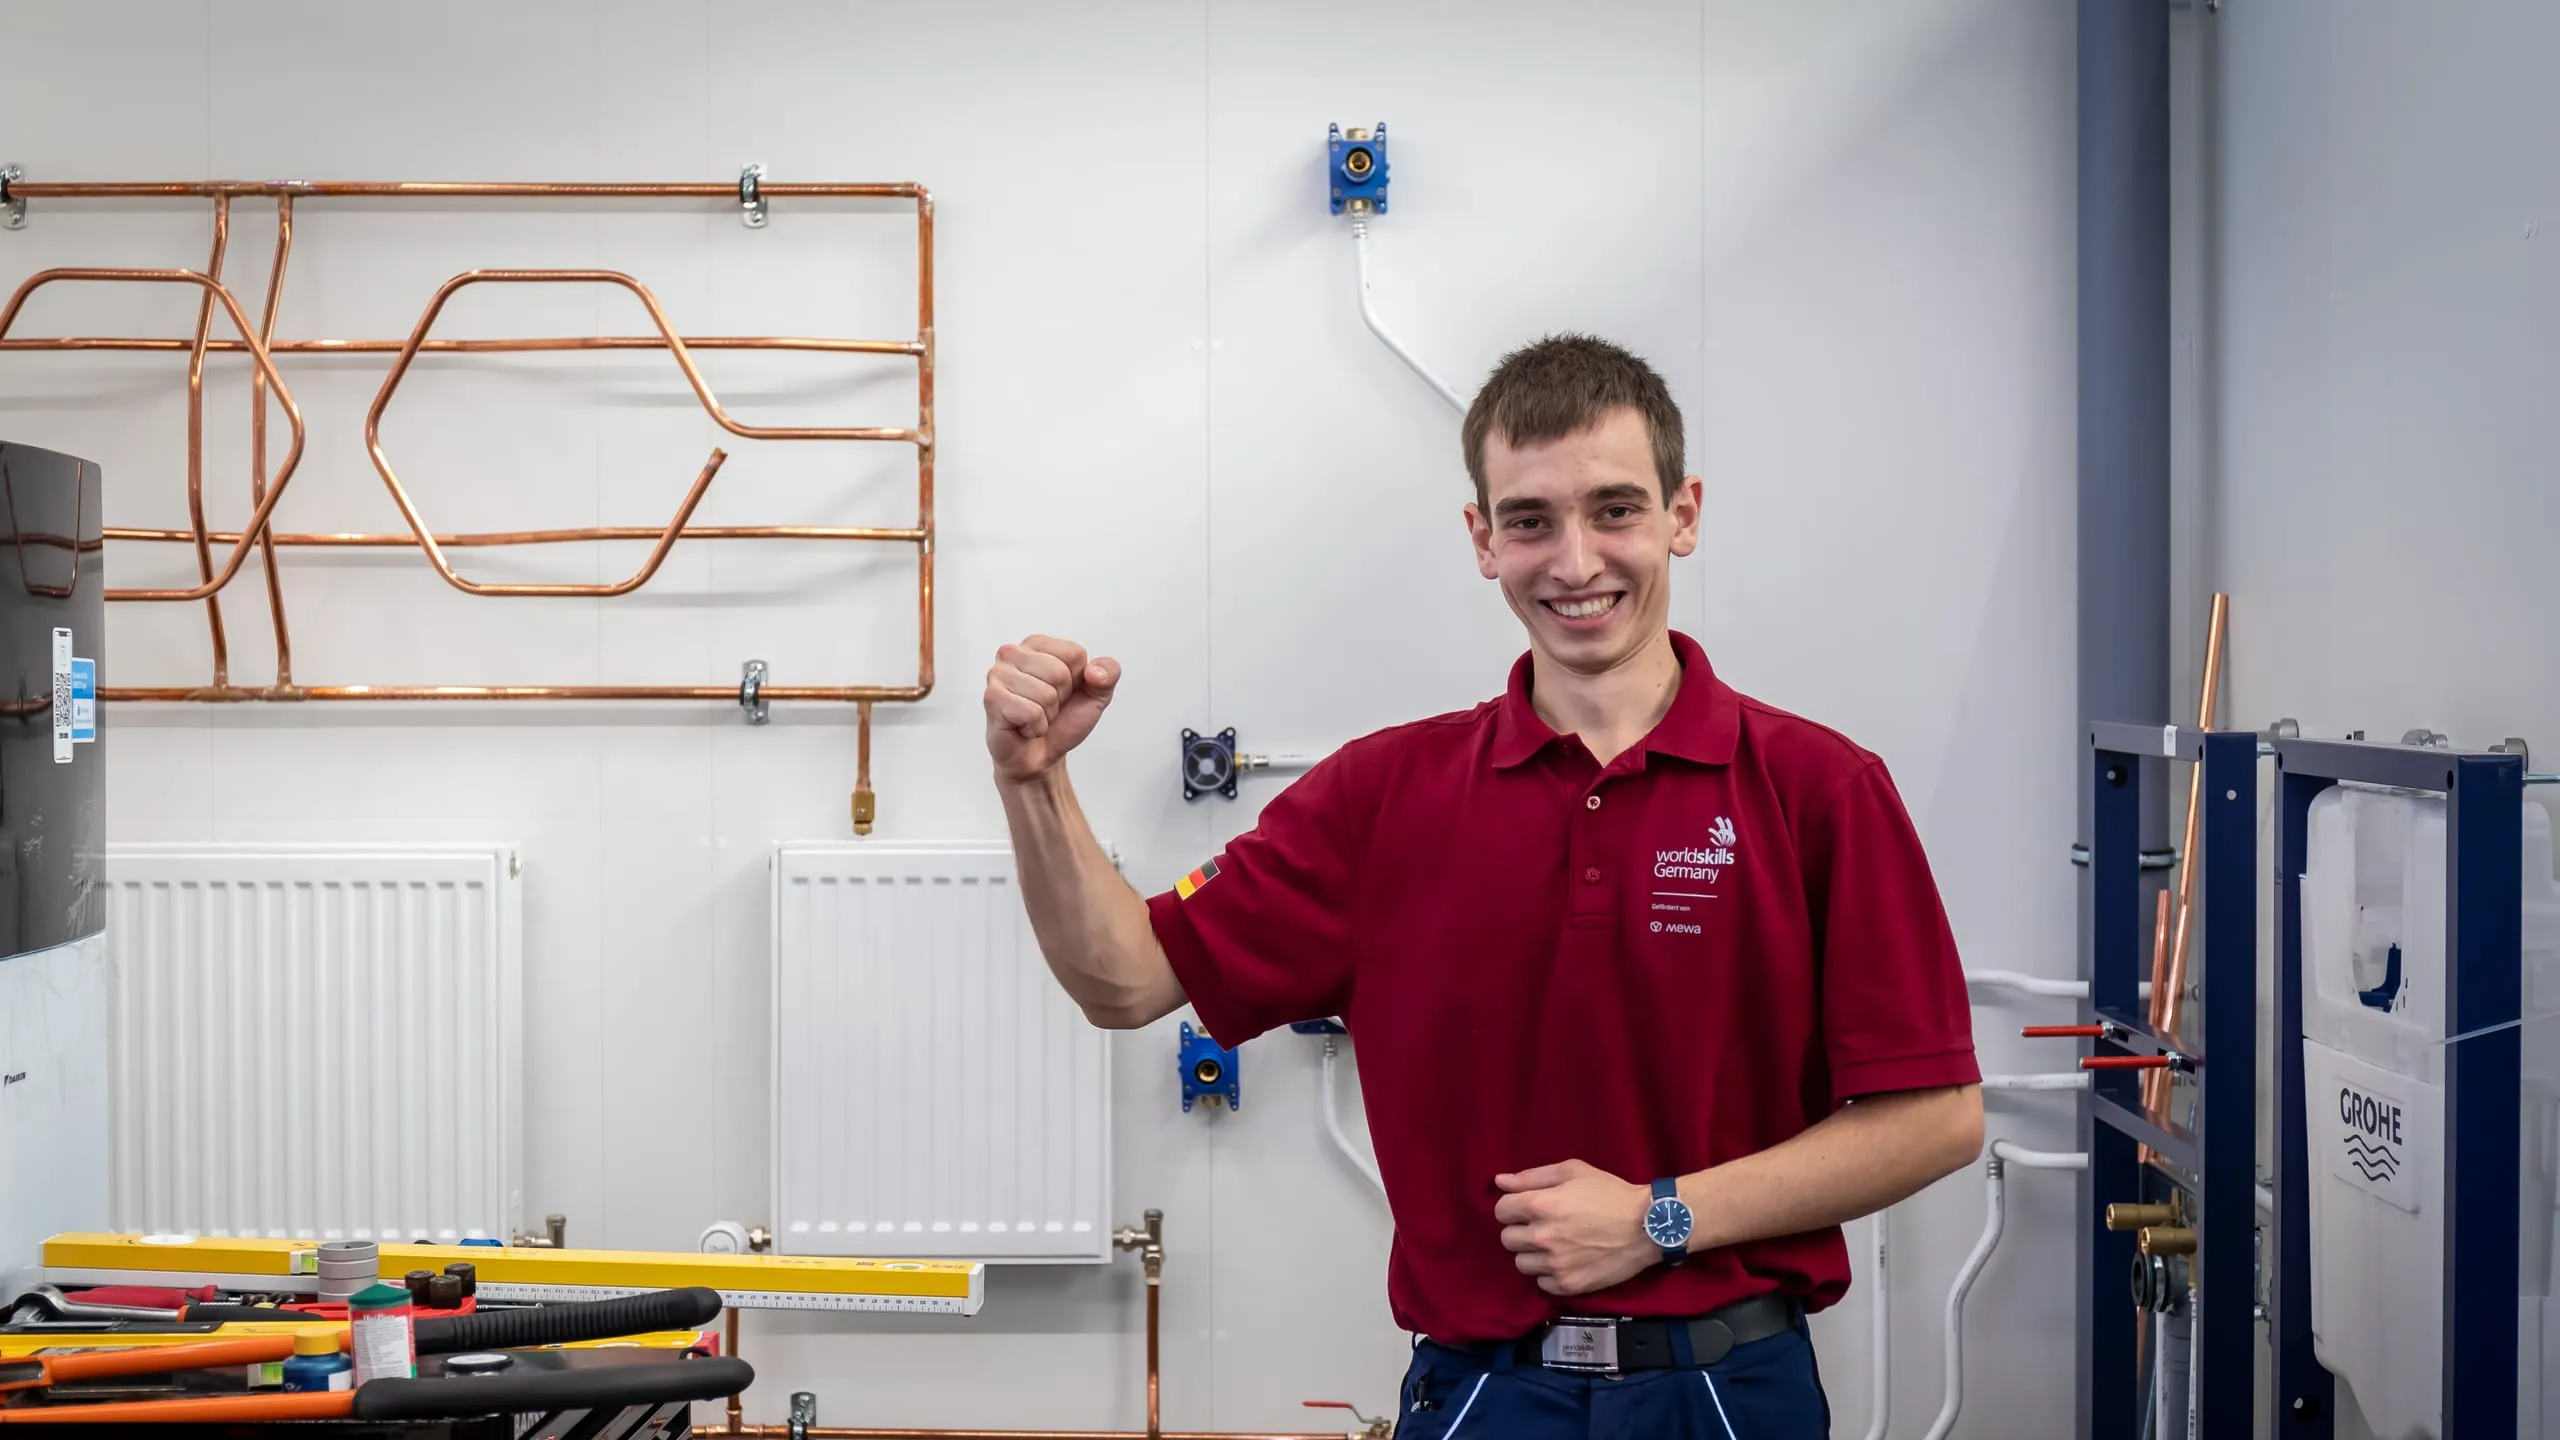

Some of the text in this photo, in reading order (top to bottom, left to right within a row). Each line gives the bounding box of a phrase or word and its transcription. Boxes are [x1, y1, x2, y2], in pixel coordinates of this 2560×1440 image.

[1656, 847, 1735, 864] worldskills
[1654, 862, 1719, 884] Germany
[2340, 1087, 2403, 1146] GROHE
